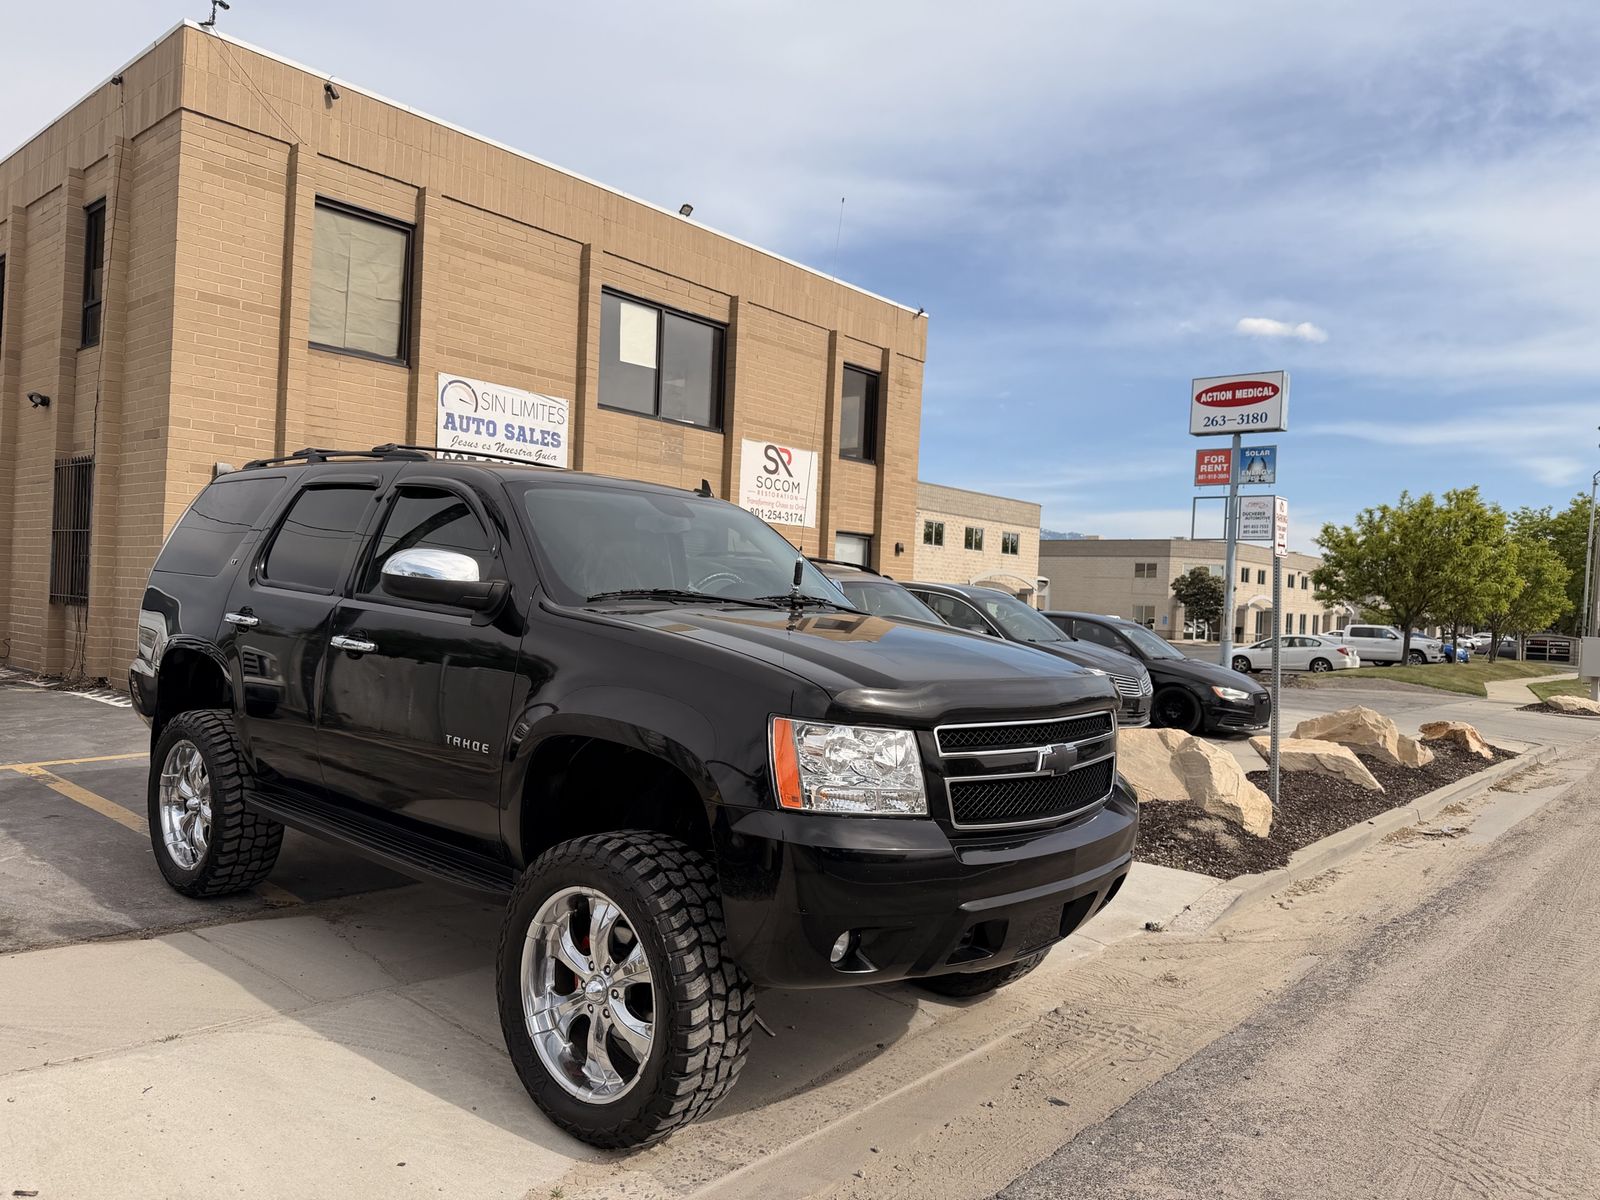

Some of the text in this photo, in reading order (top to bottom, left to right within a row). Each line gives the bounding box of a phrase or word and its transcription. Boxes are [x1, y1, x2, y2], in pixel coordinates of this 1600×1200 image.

[1200, 386, 1275, 403] ACTION MEDICAL
[480, 391, 566, 425] SIN LIMITES
[1203, 411, 1268, 427] 263-3180
[443, 412, 562, 449] AUTO SALES
[450, 435, 479, 448] Jesus
[481, 442, 492, 450] es
[494, 442, 533, 457] Nuestra
[1200, 463, 1229, 473] RENT
[1204, 455, 1226, 464] FOR
[756, 475, 801, 495] SOCOM
[757, 490, 799, 500] RESTORATION
[749, 507, 803, 523] 801-254-3174
[446, 734, 490, 754] TAHOE
